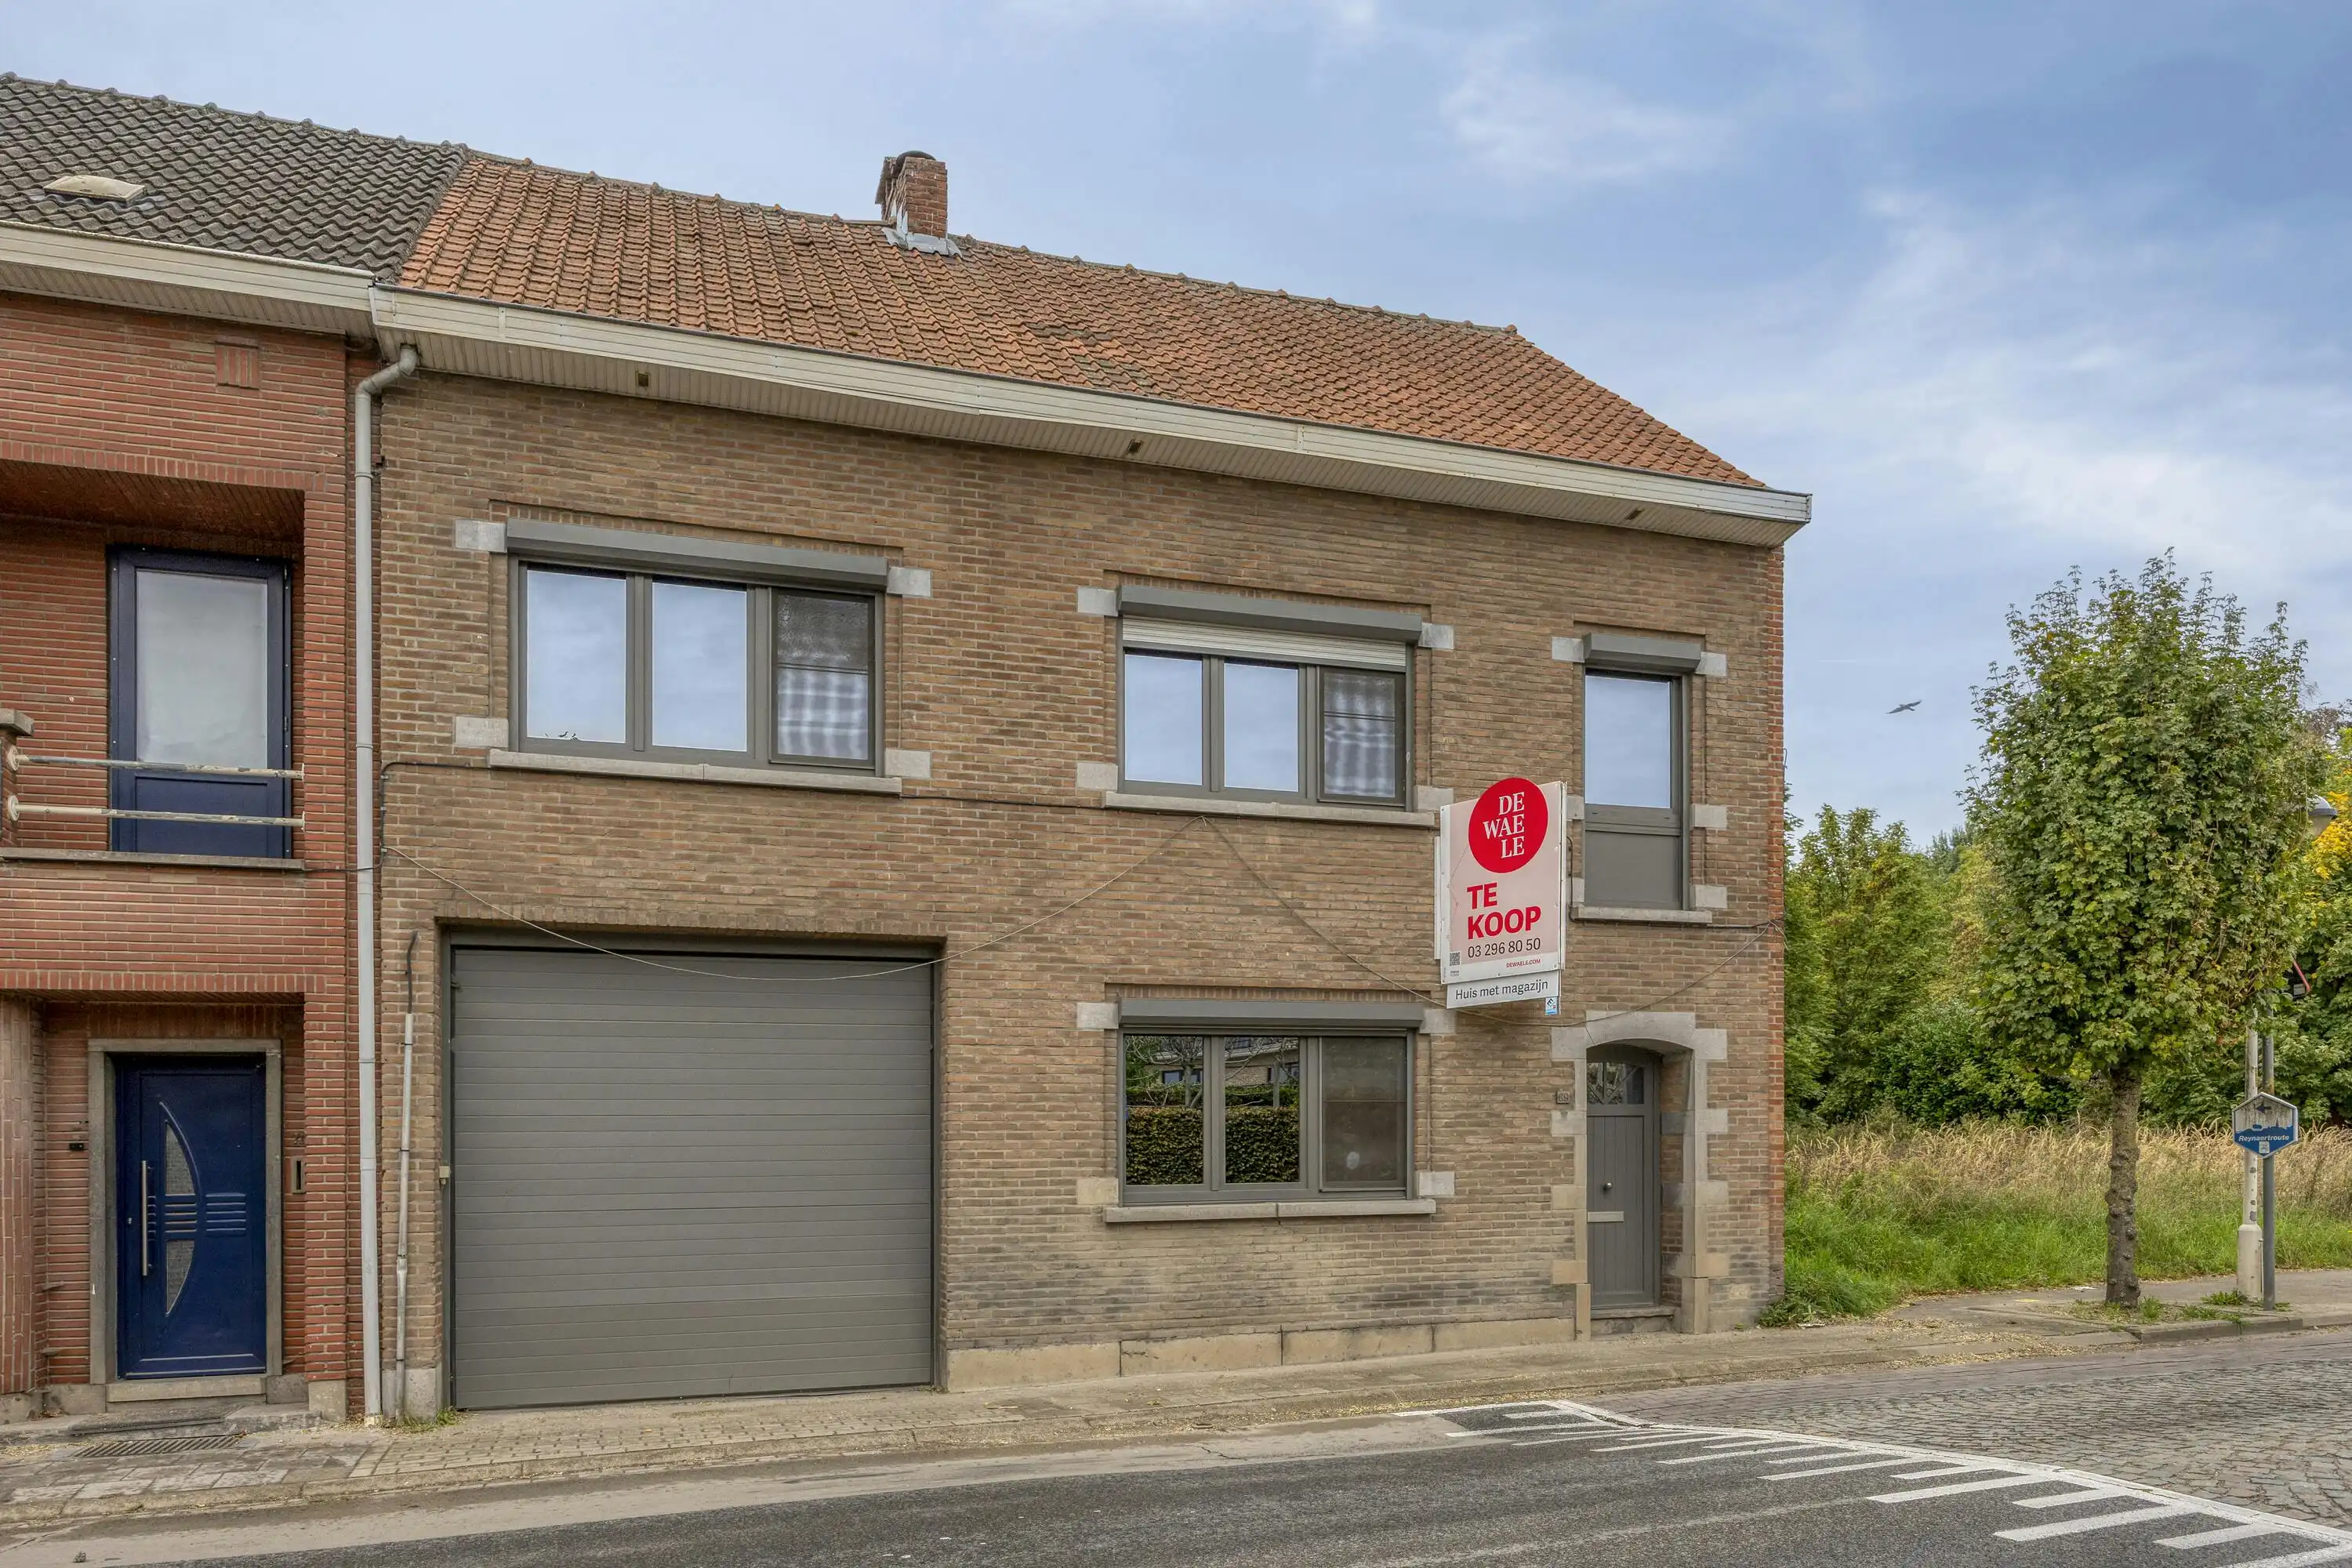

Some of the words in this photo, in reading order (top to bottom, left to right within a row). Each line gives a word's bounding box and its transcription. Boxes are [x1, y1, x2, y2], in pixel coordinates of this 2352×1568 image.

[1498, 791, 1525, 815] DE
[1483, 814, 1525, 840] WAE
[1501, 836, 1525, 859] LE
[1467, 882, 1497, 909] TE
[1468, 906, 1541, 940] KOOP
[1468, 945, 1481, 958] 03
[1484, 942, 1505, 956] 296
[1508, 939, 1523, 953] 80
[1526, 937, 1541, 951] 50
[1506, 959, 1541, 968] DEWAELE.COM
[1455, 989, 1477, 1000] Huis
[1480, 985, 1500, 997] met
[1502, 979, 1548, 996] magazijn
